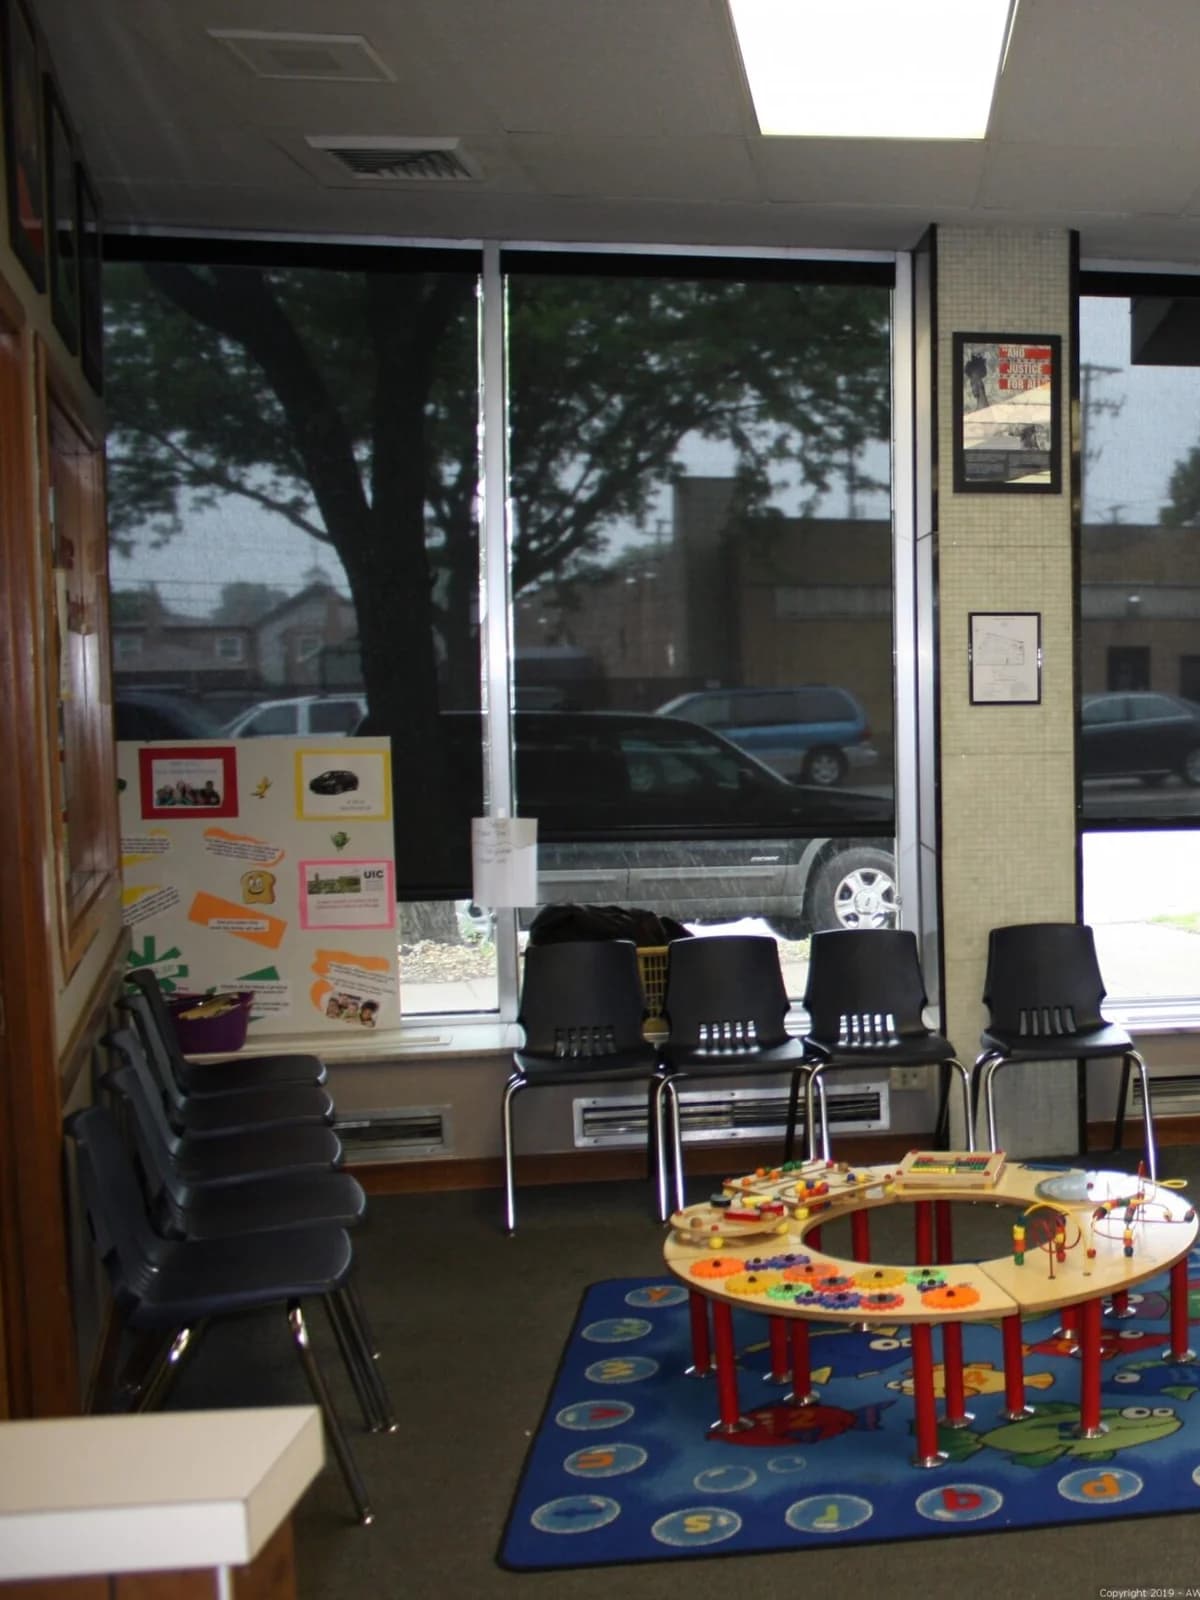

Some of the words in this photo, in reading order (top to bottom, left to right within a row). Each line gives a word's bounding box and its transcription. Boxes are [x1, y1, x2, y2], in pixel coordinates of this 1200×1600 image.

[1007, 363, 1042, 374] JUSTICE
[1007, 378, 1024, 389] FOR
[363, 869, 385, 879] UIC
